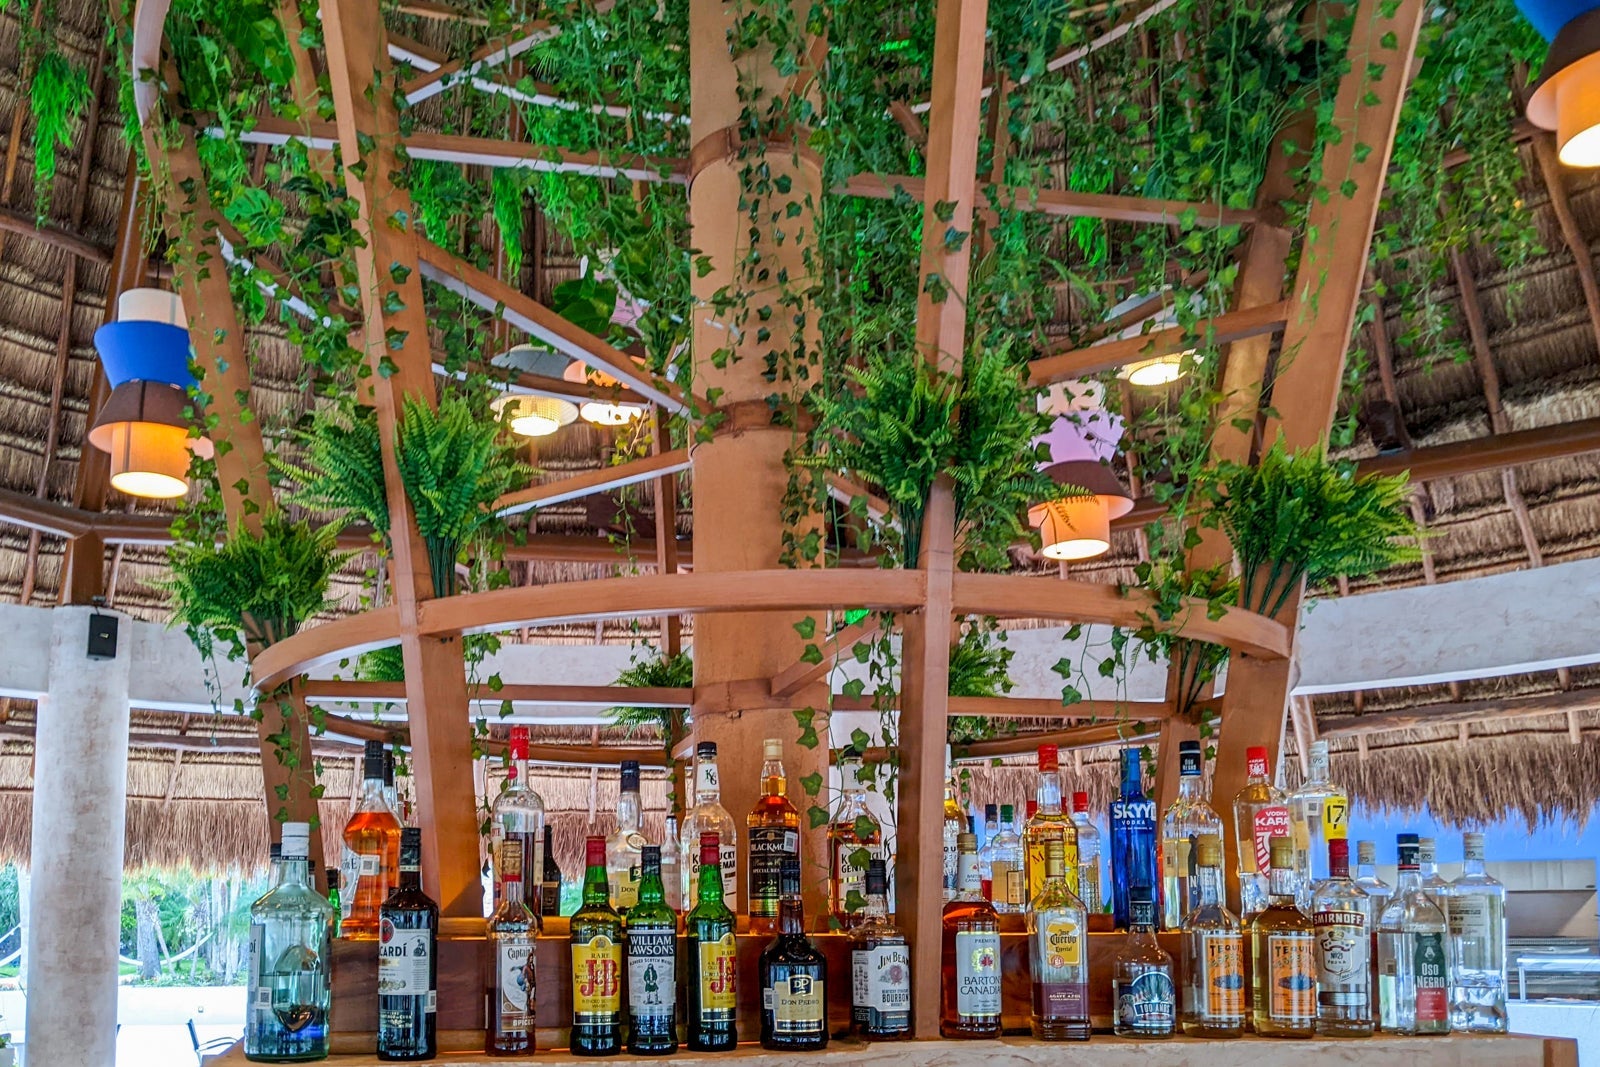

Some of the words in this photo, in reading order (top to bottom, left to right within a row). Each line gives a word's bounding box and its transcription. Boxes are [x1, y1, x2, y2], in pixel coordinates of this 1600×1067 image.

[1113, 803, 1151, 819] SKYY
[751, 842, 785, 852] BLACKMO
[1314, 911, 1362, 926] SMIRNOFF
[630, 935, 672, 945] WILLIAM
[1050, 933, 1077, 945] Cuervo
[628, 945, 674, 955] LAWSON'S
[878, 954, 892, 970] JIM
[1421, 962, 1439, 976] OSO
[794, 978, 809, 990] DP
[1416, 975, 1445, 988] NEGRO
[881, 993, 909, 1003] BOURBON
